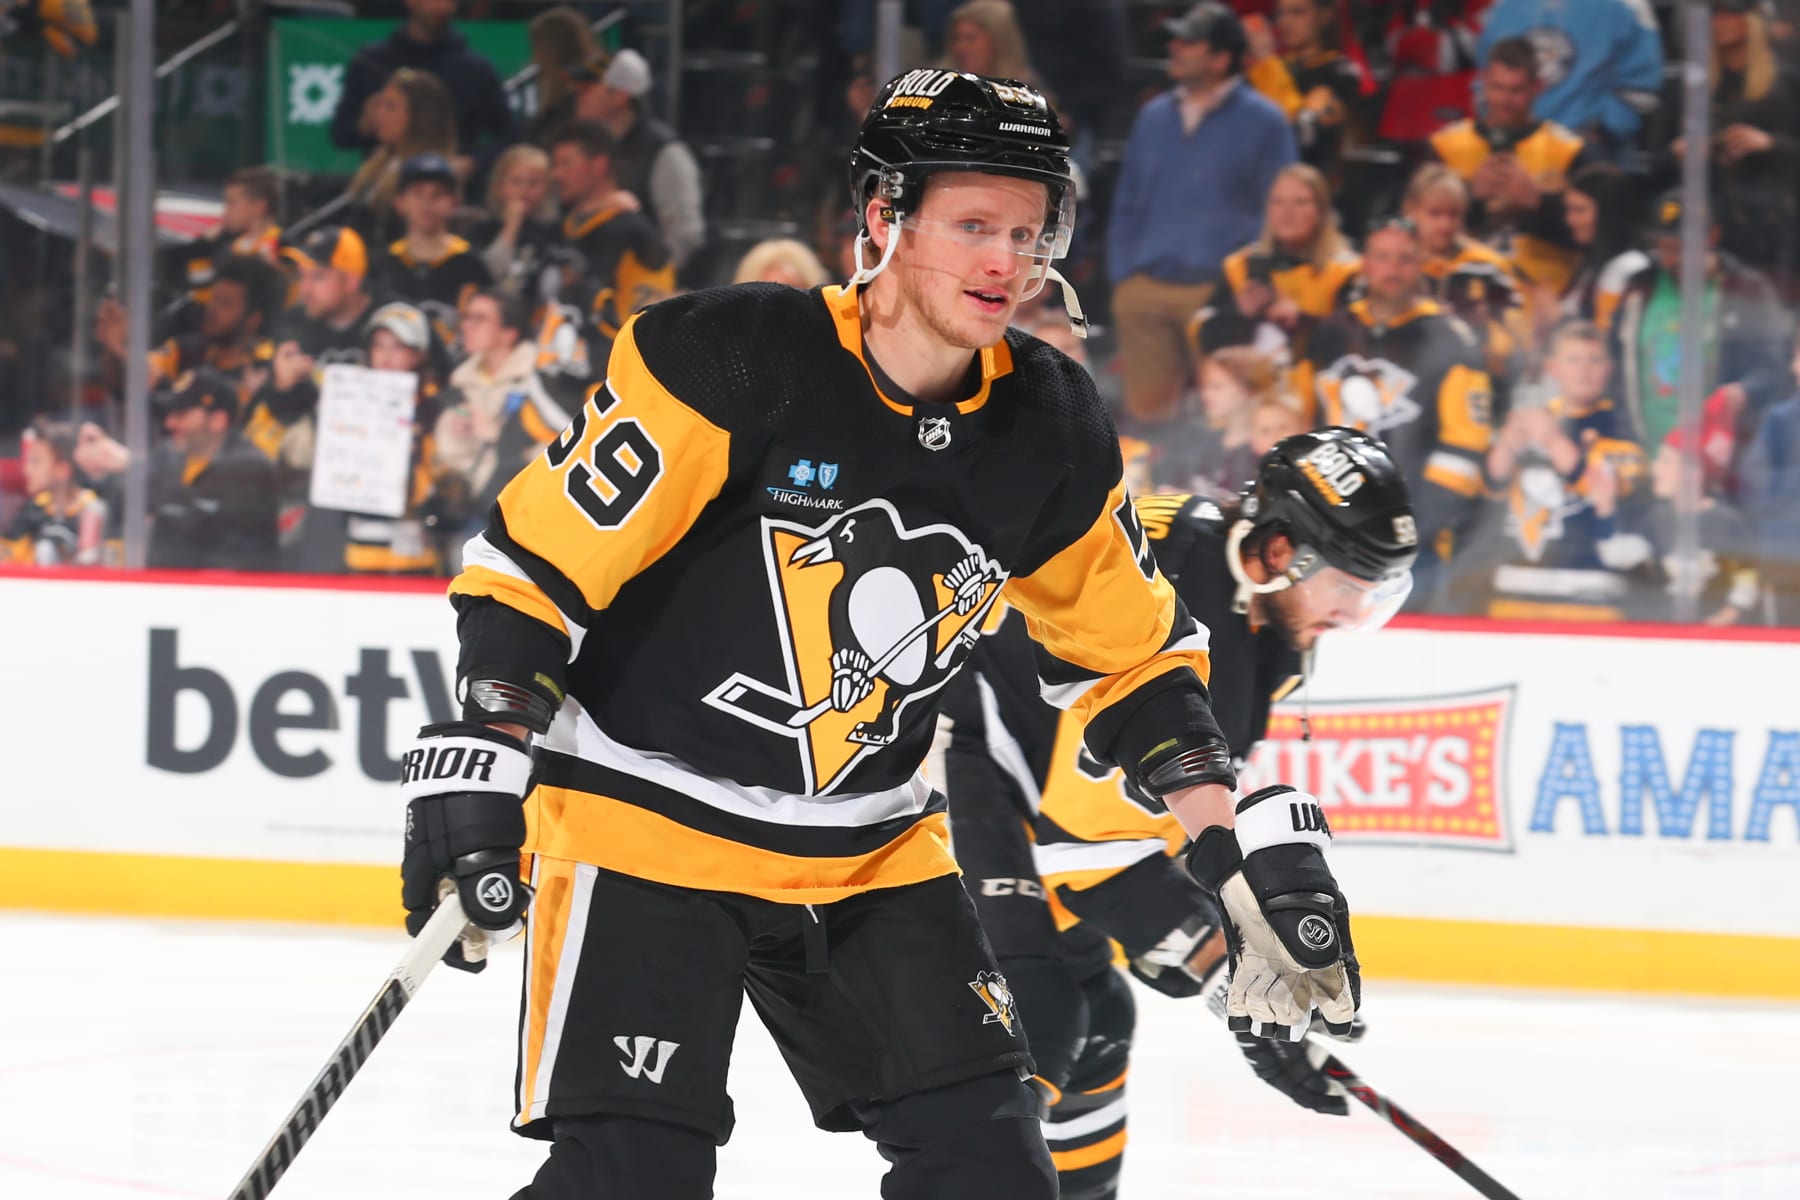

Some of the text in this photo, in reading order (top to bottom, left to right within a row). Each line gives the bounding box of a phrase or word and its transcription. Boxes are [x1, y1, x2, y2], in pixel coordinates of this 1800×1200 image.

[894, 69, 955, 97] BOLD
[999, 122, 1051, 137] WARRIOR
[773, 490, 843, 510] HIGHMARK
